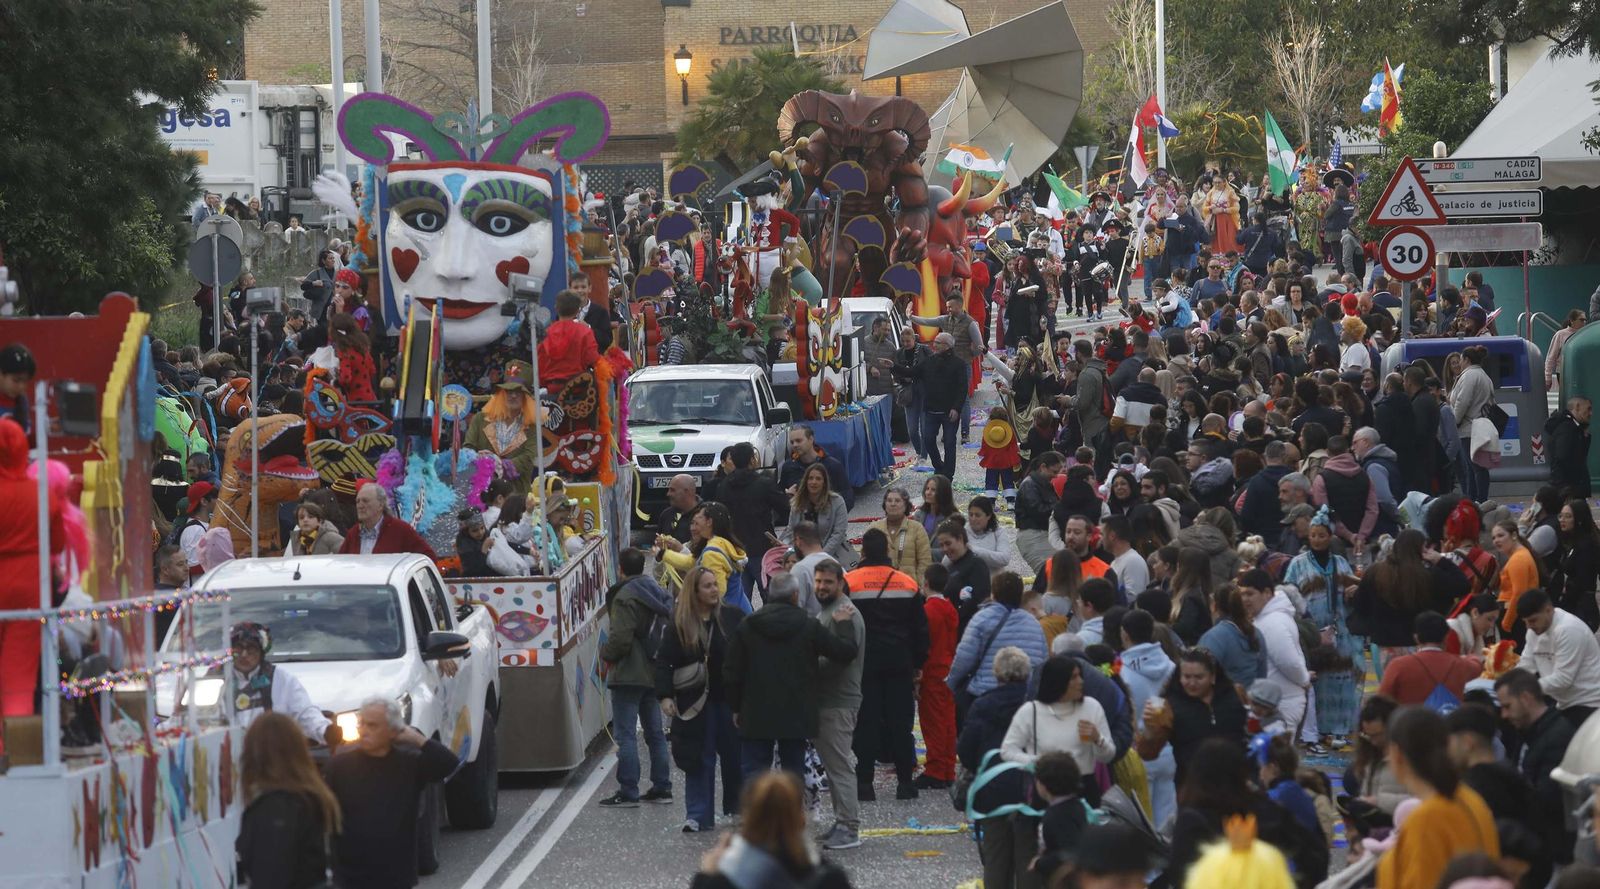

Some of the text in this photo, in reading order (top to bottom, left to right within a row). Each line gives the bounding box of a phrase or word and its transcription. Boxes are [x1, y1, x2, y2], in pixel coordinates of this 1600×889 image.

[719, 24, 859, 45] PARROQUIA
[159, 108, 231, 133] gesa
[1480, 201, 1492, 209] de
[1498, 200, 1536, 209] justicia
[1392, 245, 1423, 264] 30
